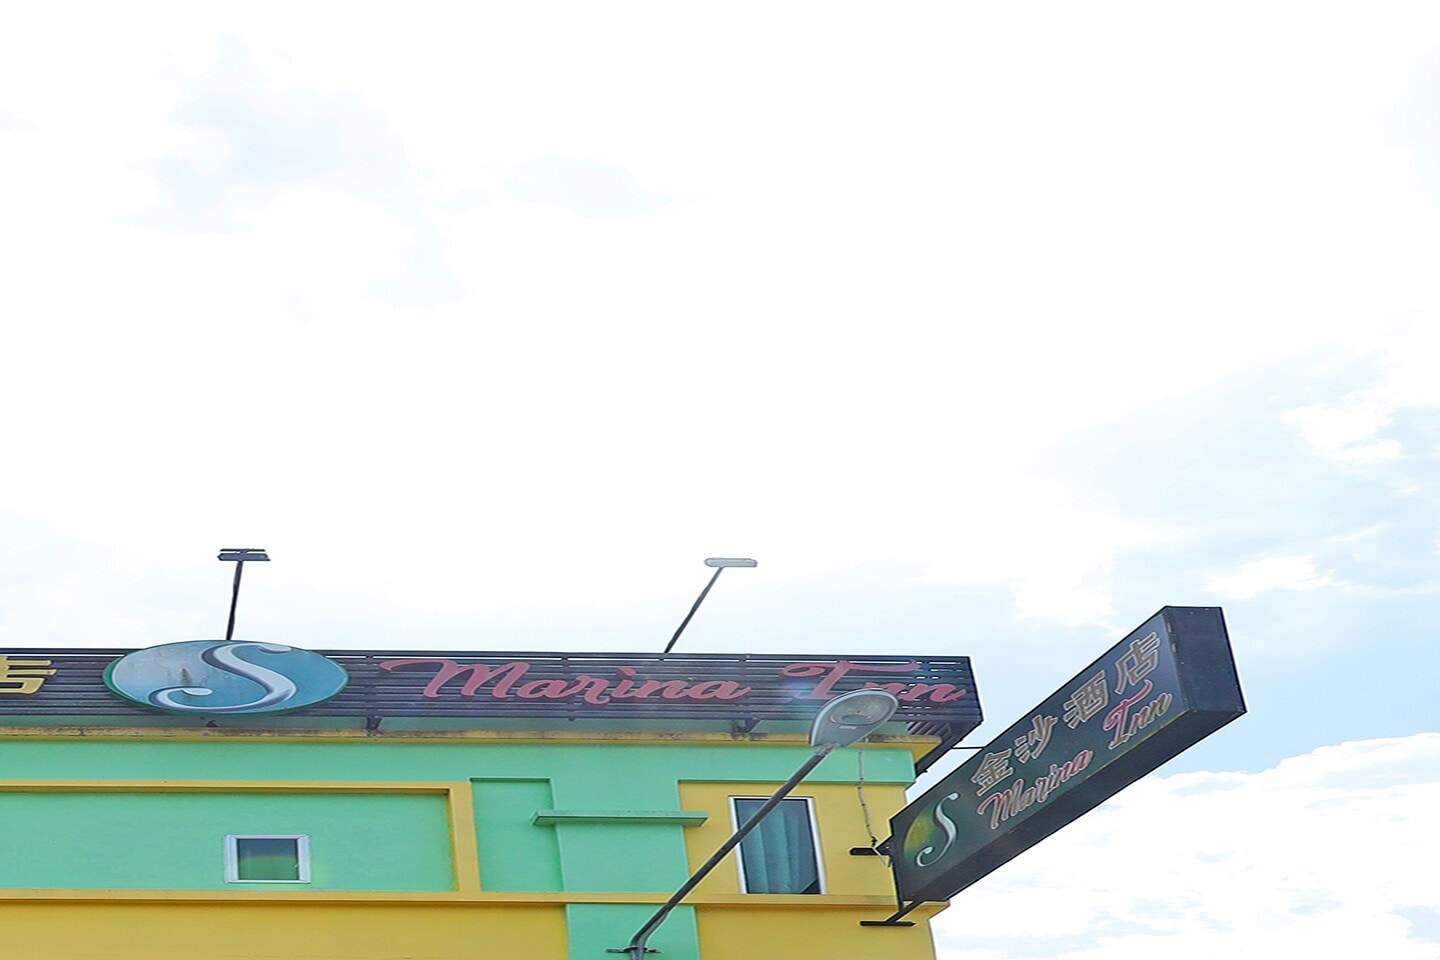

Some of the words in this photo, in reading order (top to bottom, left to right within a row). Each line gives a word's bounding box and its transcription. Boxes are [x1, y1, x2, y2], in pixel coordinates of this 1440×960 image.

[380, 659, 752, 704] Marina
[971, 631, 1161, 796] 金沙酒店
[976, 749, 1094, 830] Marina
[1103, 679, 1173, 750] Inn
